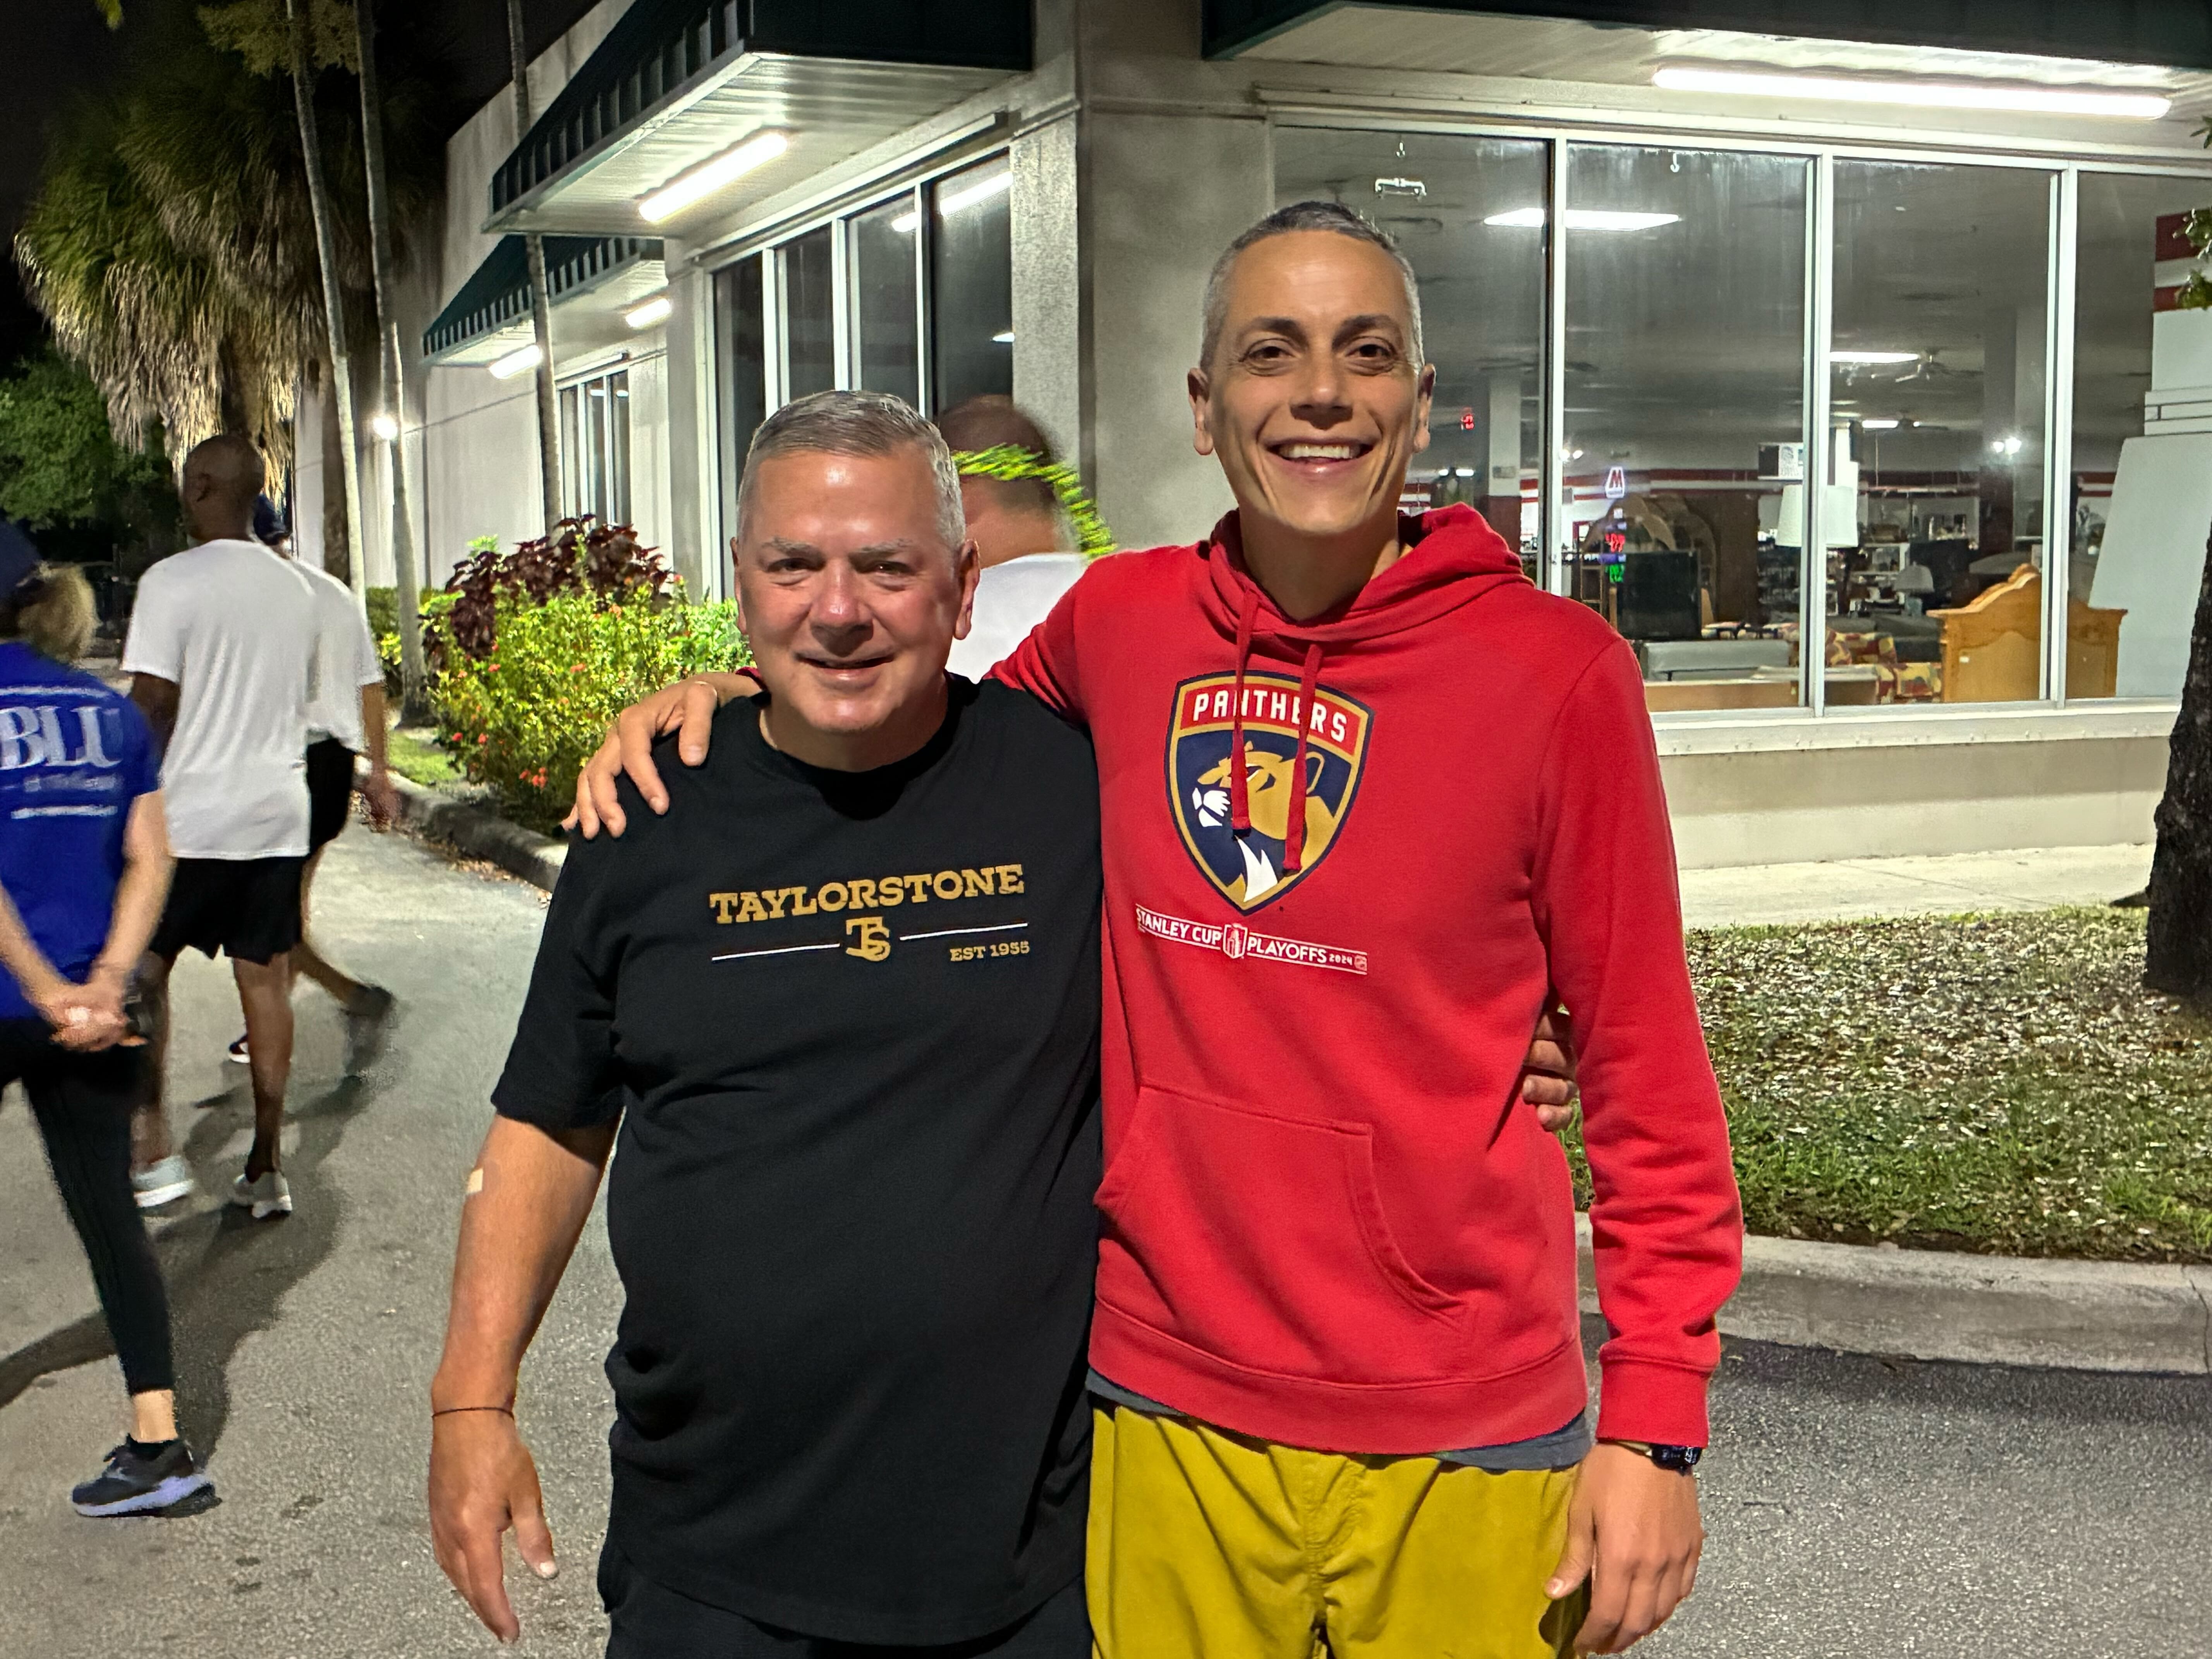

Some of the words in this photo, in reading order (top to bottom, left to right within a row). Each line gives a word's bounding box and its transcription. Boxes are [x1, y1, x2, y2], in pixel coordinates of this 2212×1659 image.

[1193, 689, 1347, 743] PANTHERS
[709, 864, 1025, 924] TAYLORSTONE
[950, 946, 986, 962] EST
[989, 940, 1030, 957] 1955
[1136, 908, 1190, 939] STANLEY
[1192, 927, 1222, 945] CUP
[1247, 936, 1327, 963] PLAYOFFS
[1329, 953, 1353, 966] 2024
